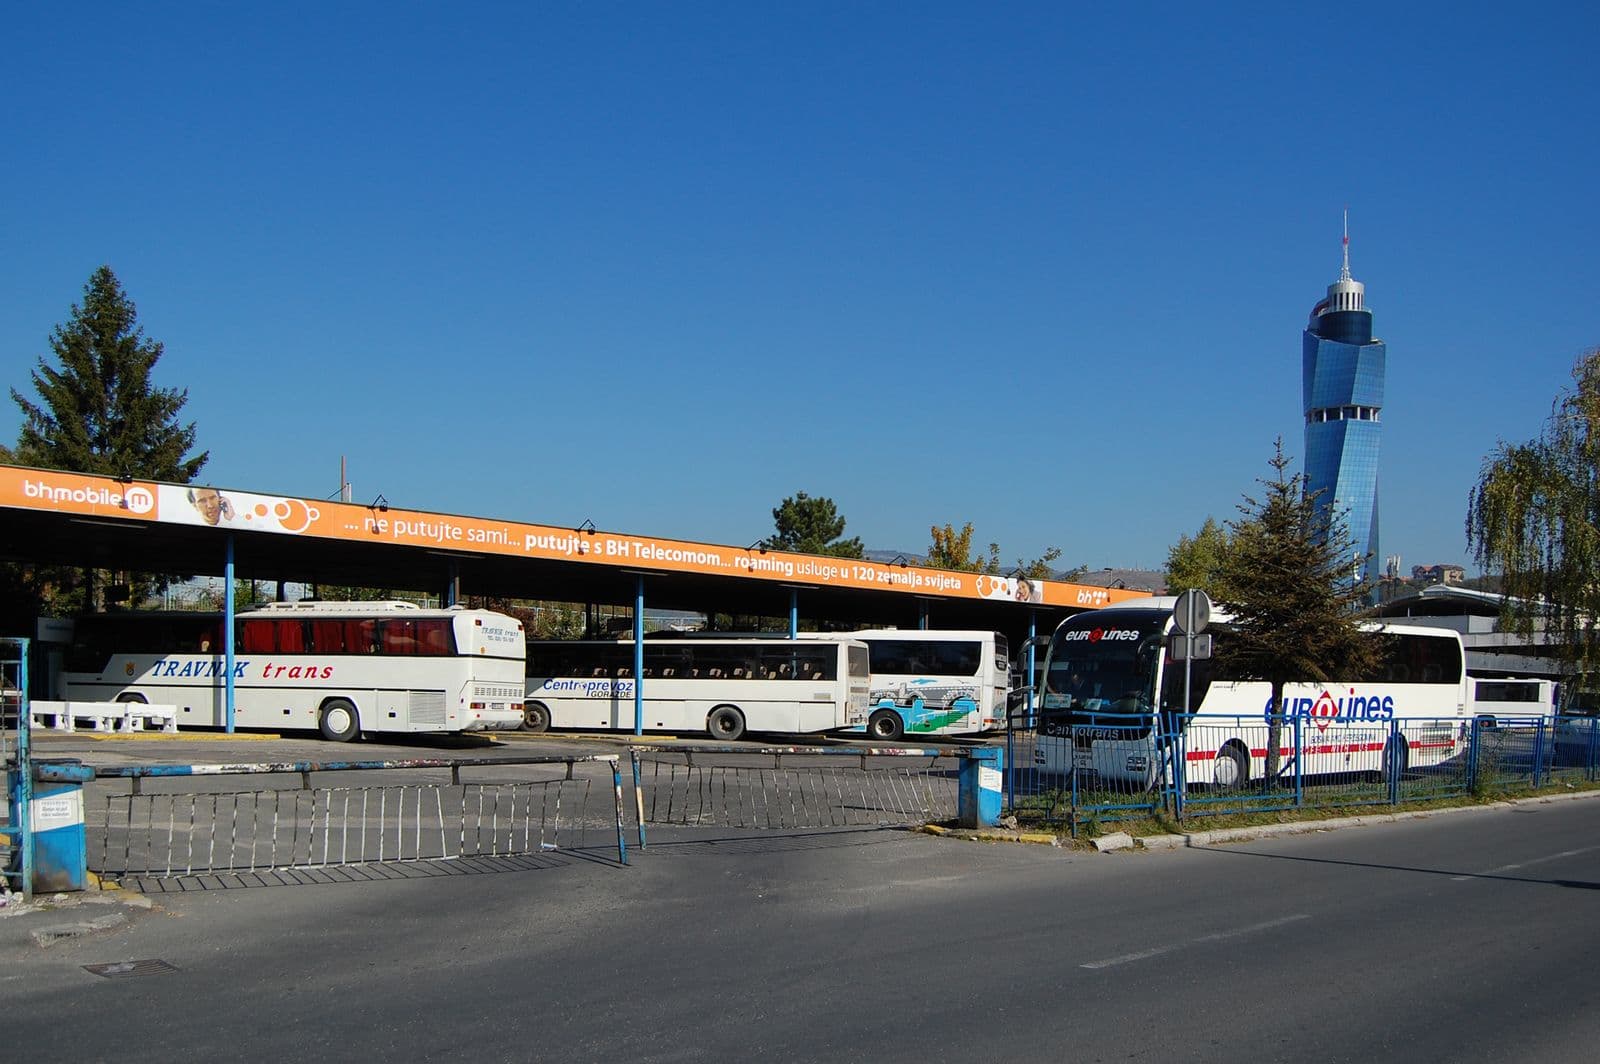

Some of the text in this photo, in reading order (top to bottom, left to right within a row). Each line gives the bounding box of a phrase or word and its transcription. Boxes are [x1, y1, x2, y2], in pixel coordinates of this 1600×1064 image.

[24, 480, 123, 506] bhmobile
[364, 517, 389, 533] ne
[393, 519, 463, 542] putujte
[466, 528, 521, 546] sami...
[525, 533, 590, 556] putujte
[594, 541, 602, 555] s
[606, 539, 630, 557] BH
[632, 542, 732, 567] Telecomom...
[734, 556, 794, 577] roaming
[796, 561, 838, 580] usluge
[840, 567, 849, 579] u
[852, 566, 875, 581] 120
[877, 570, 923, 589] zemalja
[924, 573, 961, 591] svijeta
[262, 662, 334, 679] trans
[1047, 722, 1119, 739] Cenotrans
